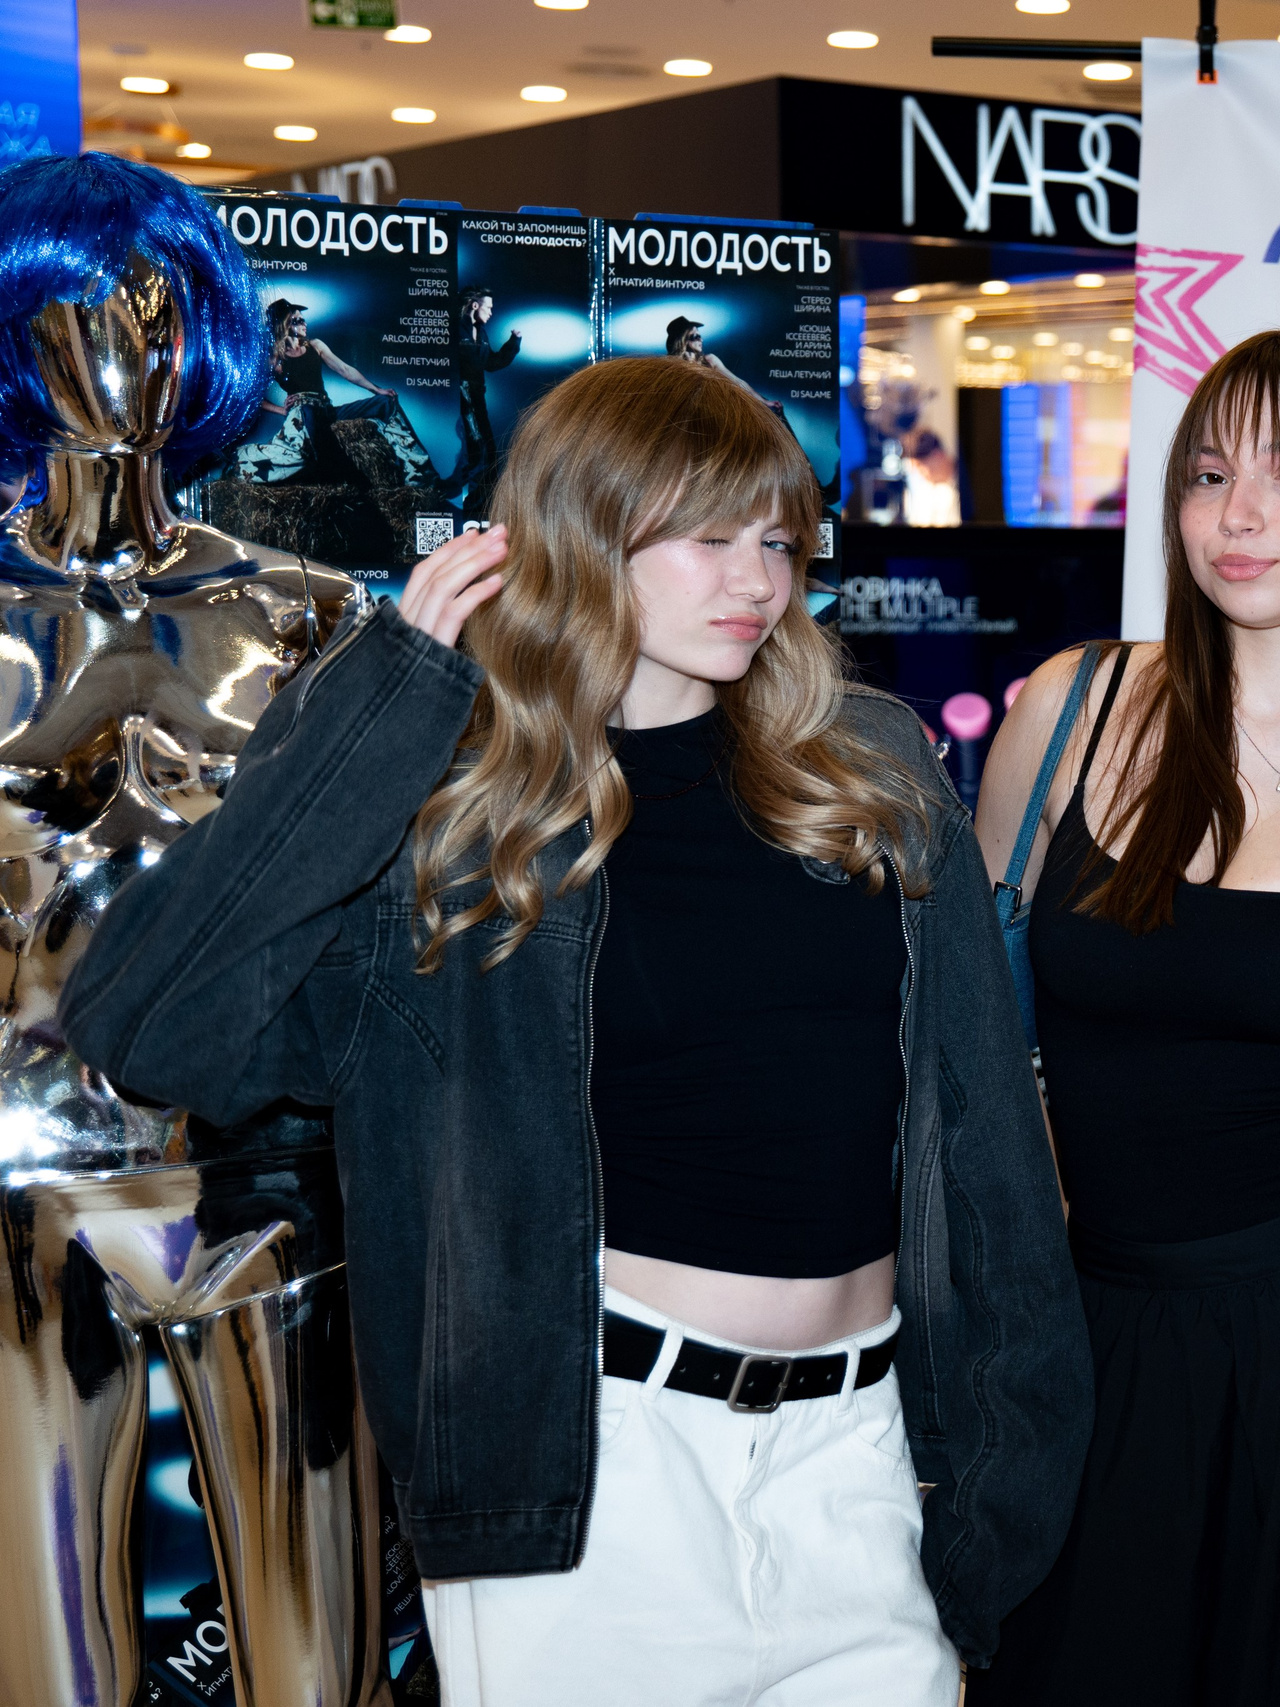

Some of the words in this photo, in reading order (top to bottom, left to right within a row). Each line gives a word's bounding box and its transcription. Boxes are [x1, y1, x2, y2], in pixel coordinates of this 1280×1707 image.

[902, 95, 1141, 246] NARS
[462, 220, 499, 231] КАКОЙ
[500, 221, 515, 232] ТЫ
[517, 223, 587, 235] ЗАПОМНИШЬ
[480, 233, 513, 244] СВОЮ
[515, 235, 587, 247] МОЛОДОСТЬ?
[608, 226, 832, 276] МОЛОДОСТЬ
[251, 260, 308, 272] ВИНТУРОВ
[415, 278, 449, 288] СТЕРЕО
[608, 277, 654, 288] ИГНАТИЙ
[655, 279, 706, 290] ВИНТУРОВ
[408, 287, 449, 297] ШИРИНА
[800, 296, 832, 305] СТЕРЕО
[414, 309, 450, 318] КСЮША
[793, 304, 832, 313] ШИРИНА
[400, 317, 450, 327] ICCEEEBERG
[410, 326, 418, 334] И
[419, 327, 450, 335] АРИНА
[799, 324, 832, 333] КСЮША
[382, 335, 450, 345] ARLOVEDBYYOU
[795, 341, 802, 349] И
[803, 342, 832, 350] АРИНА
[409, 356, 450, 367] ЛЕТУЧИЙ
[794, 369, 832, 380] ЛЕТУЧИЙ
[406, 377, 416, 387] DJ
[416, 378, 450, 387] SALAME
[790, 390, 799, 399] DJ
[800, 390, 832, 399] SALAME
[166, 1603, 229, 1683] МО
[204, 1665, 232, 1697] ИГНАТ
